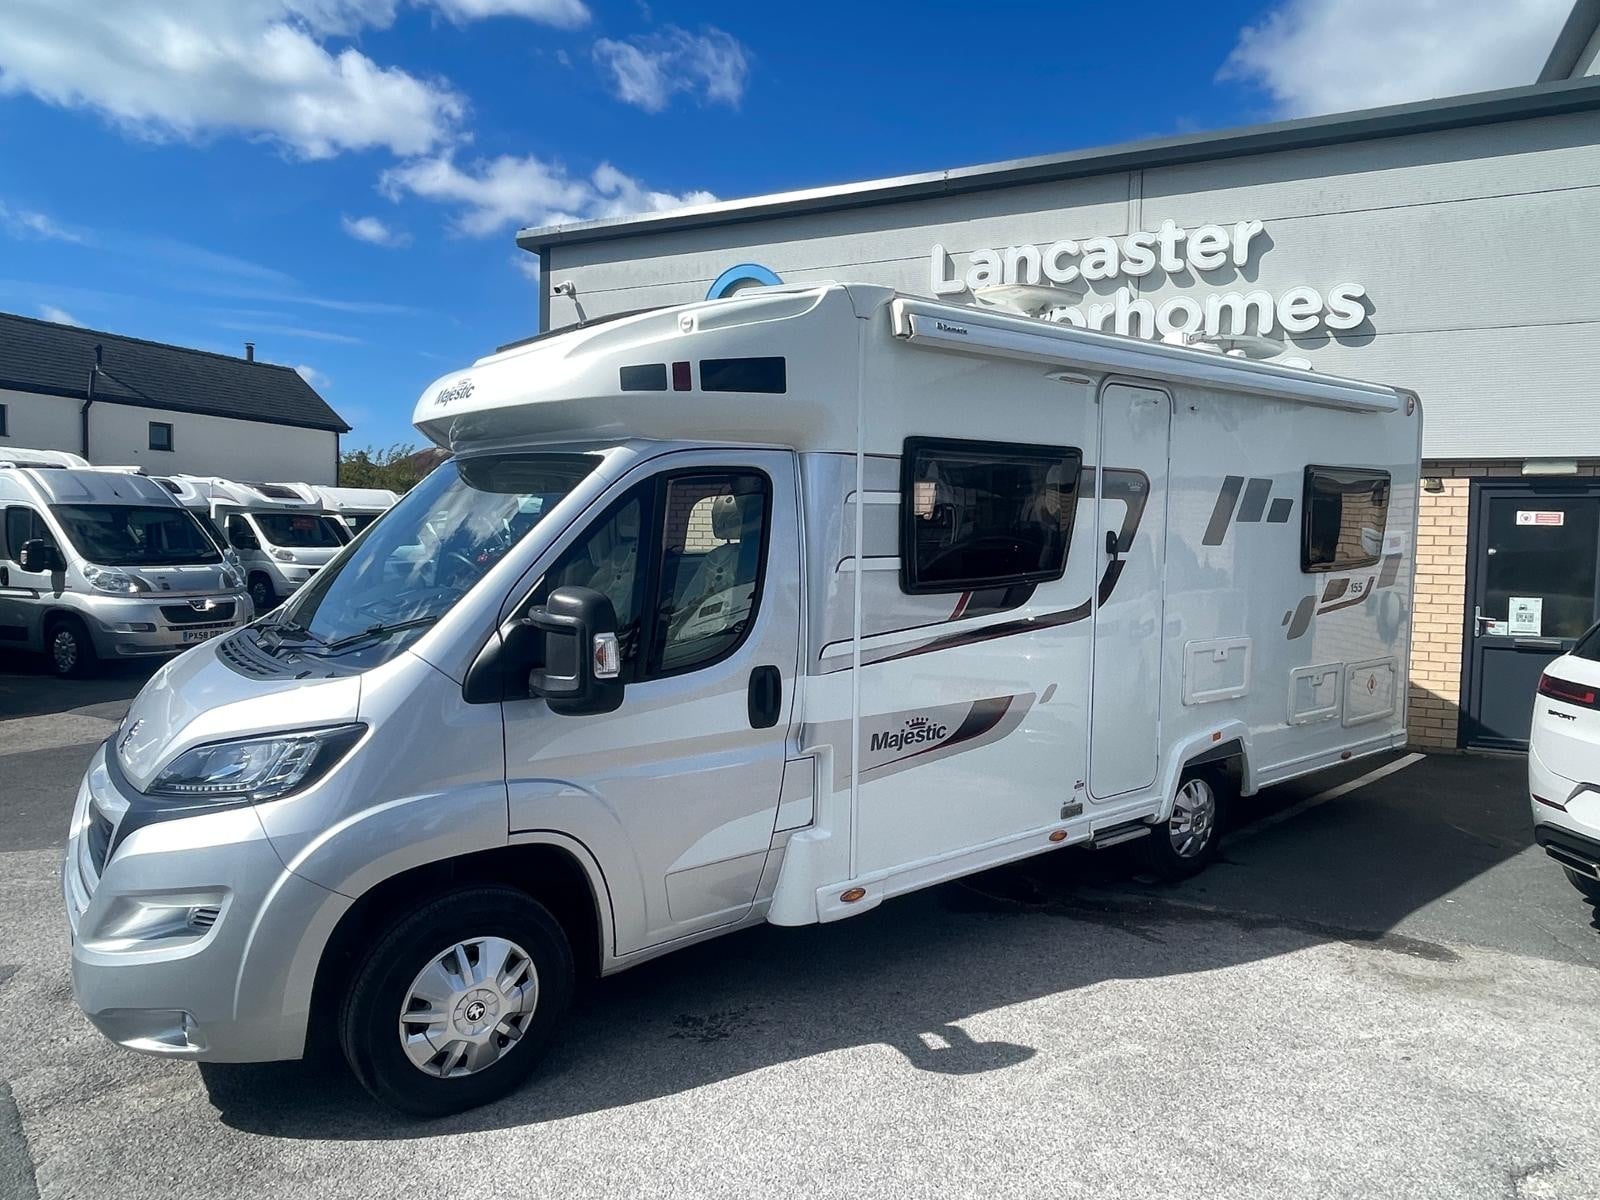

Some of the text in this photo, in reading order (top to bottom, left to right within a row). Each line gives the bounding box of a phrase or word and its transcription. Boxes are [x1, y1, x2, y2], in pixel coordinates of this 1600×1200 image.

[930, 218, 1264, 296] Lancaster
[434, 382, 476, 407] Majestic
[1350, 582, 1363, 593] 155
[1547, 709, 1577, 721] SPORT
[870, 723, 947, 752] Majestic
